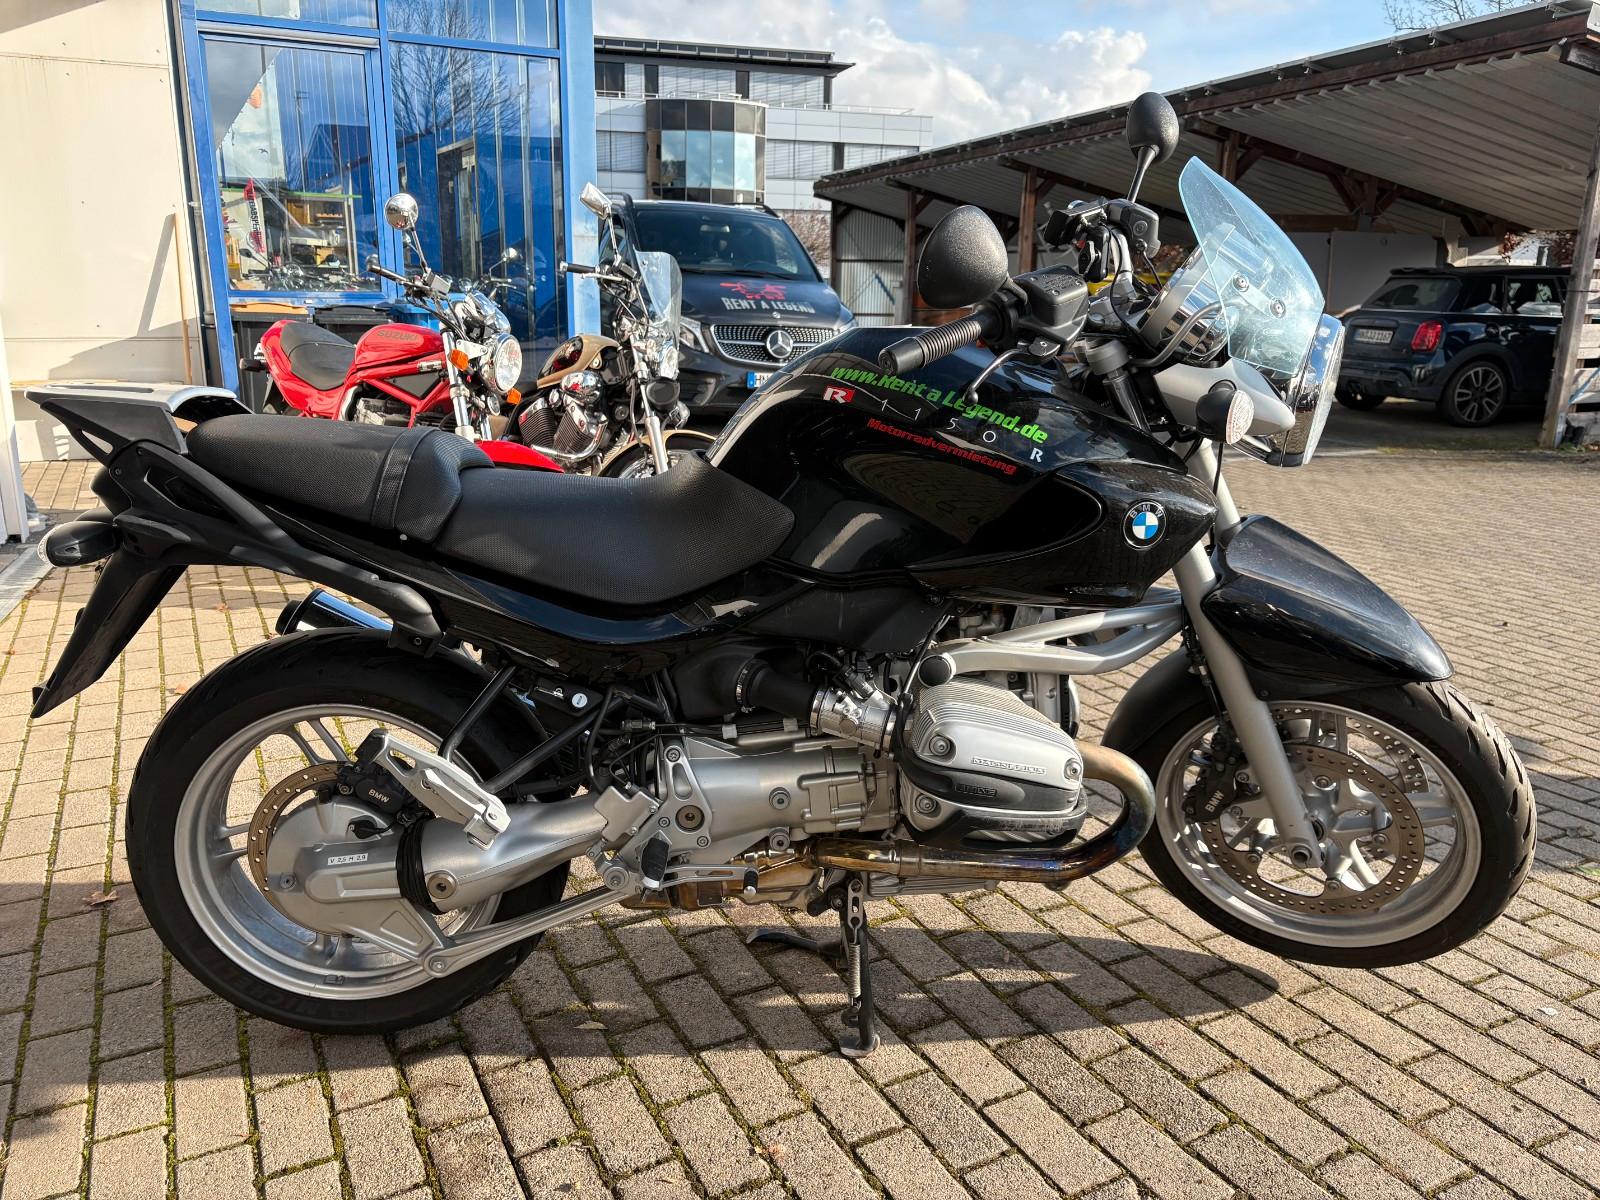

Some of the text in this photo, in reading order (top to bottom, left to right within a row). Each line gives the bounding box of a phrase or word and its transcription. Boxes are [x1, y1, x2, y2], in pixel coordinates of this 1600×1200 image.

[721, 297, 816, 314] RENT A LEGEND
[377, 330, 418, 342] SUZUKI
[823, 387, 847, 404] R
[926, 389, 941, 402] a
[866, 418, 1017, 475] Motorradvermietung
[368, 788, 390, 804] BMW
[1204, 790, 1225, 813] BMW
